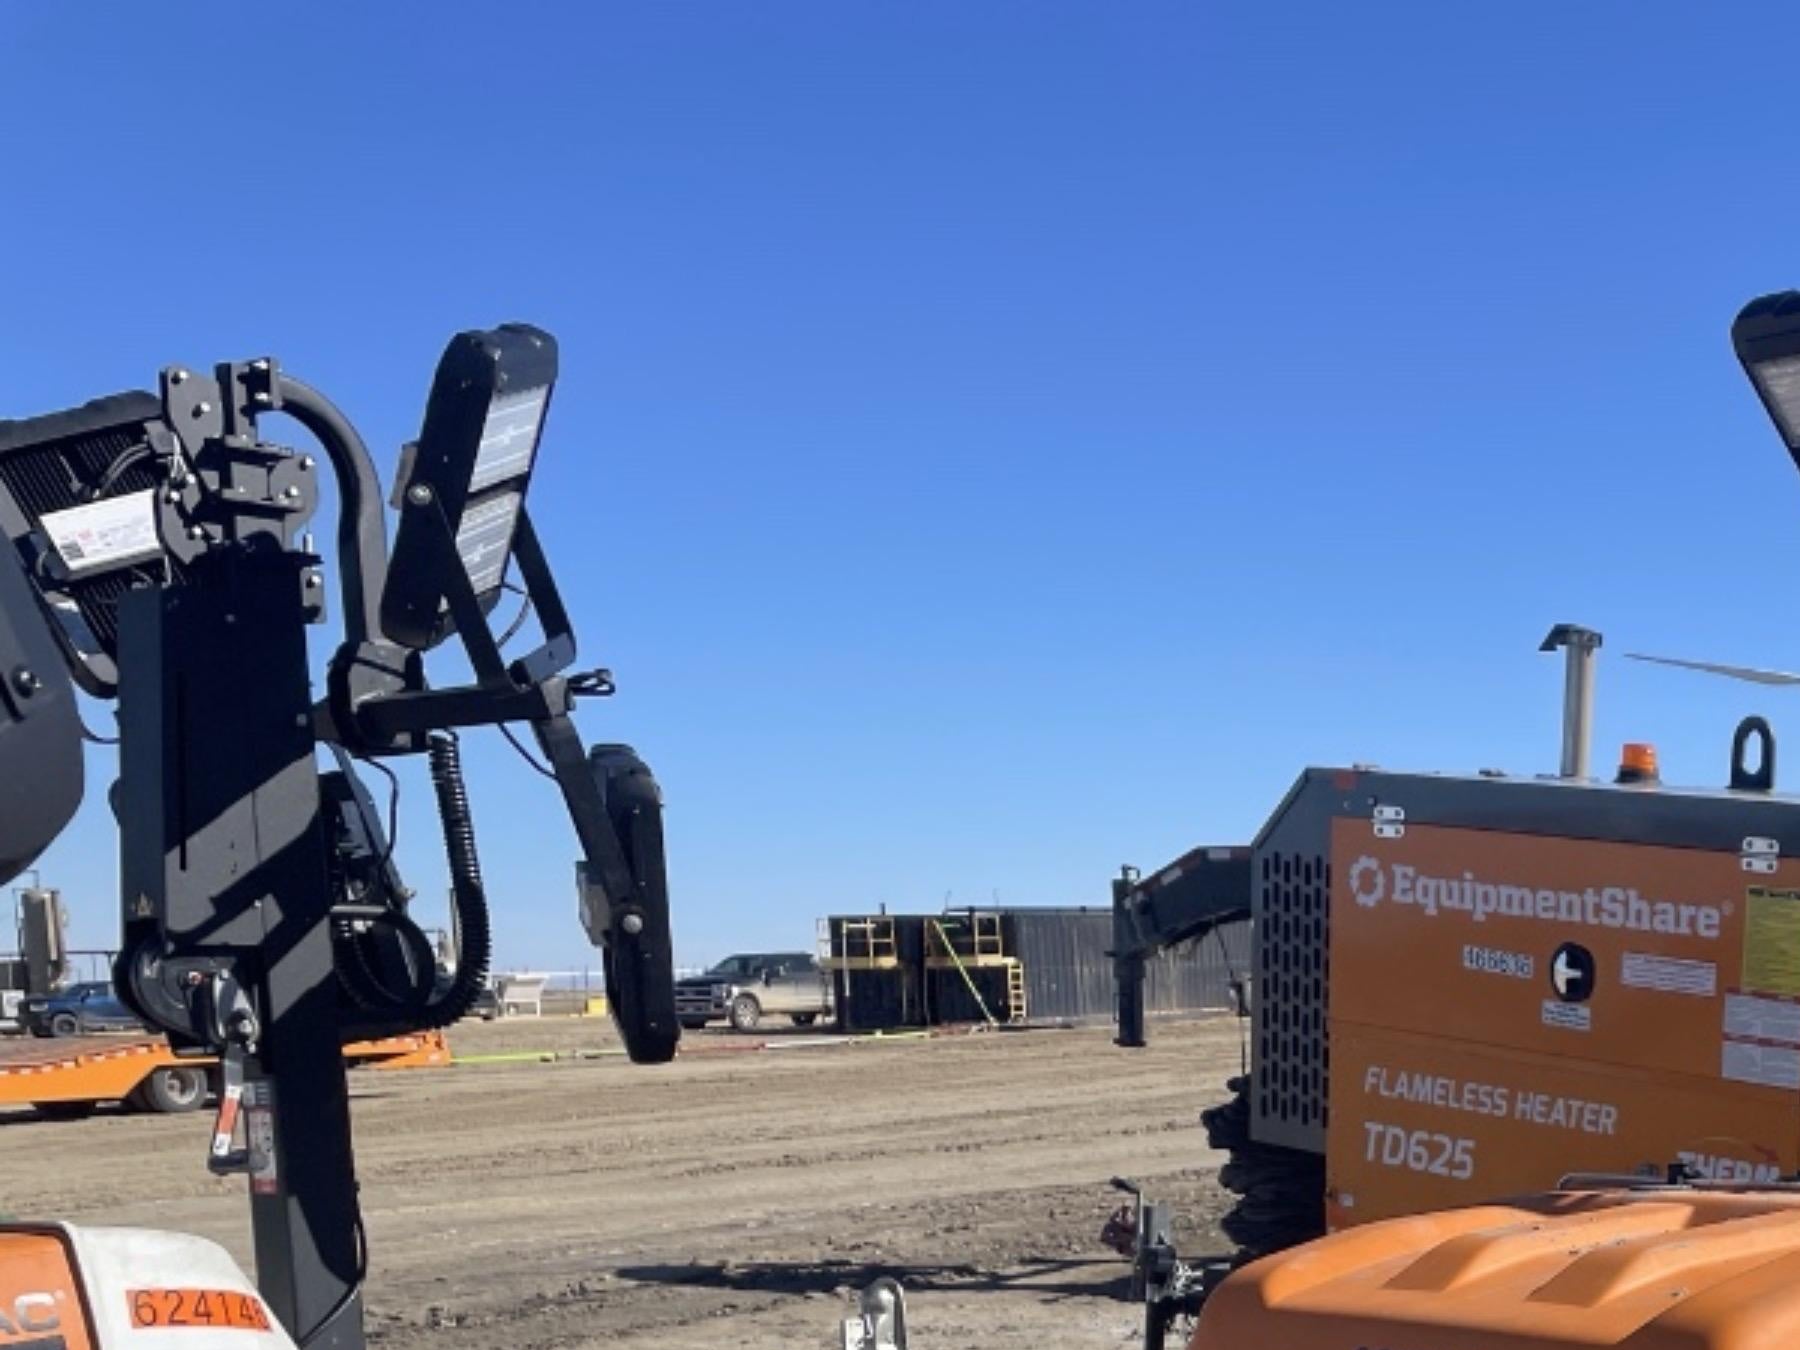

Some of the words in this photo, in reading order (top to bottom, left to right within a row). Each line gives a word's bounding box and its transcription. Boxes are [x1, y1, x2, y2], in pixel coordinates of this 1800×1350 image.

[1391, 862, 1721, 938] EquipmentShare
[1364, 1066, 1508, 1117] FLAMELESS
[1515, 1092, 1618, 1135] HEATER
[1364, 1121, 1476, 1181] TD625
